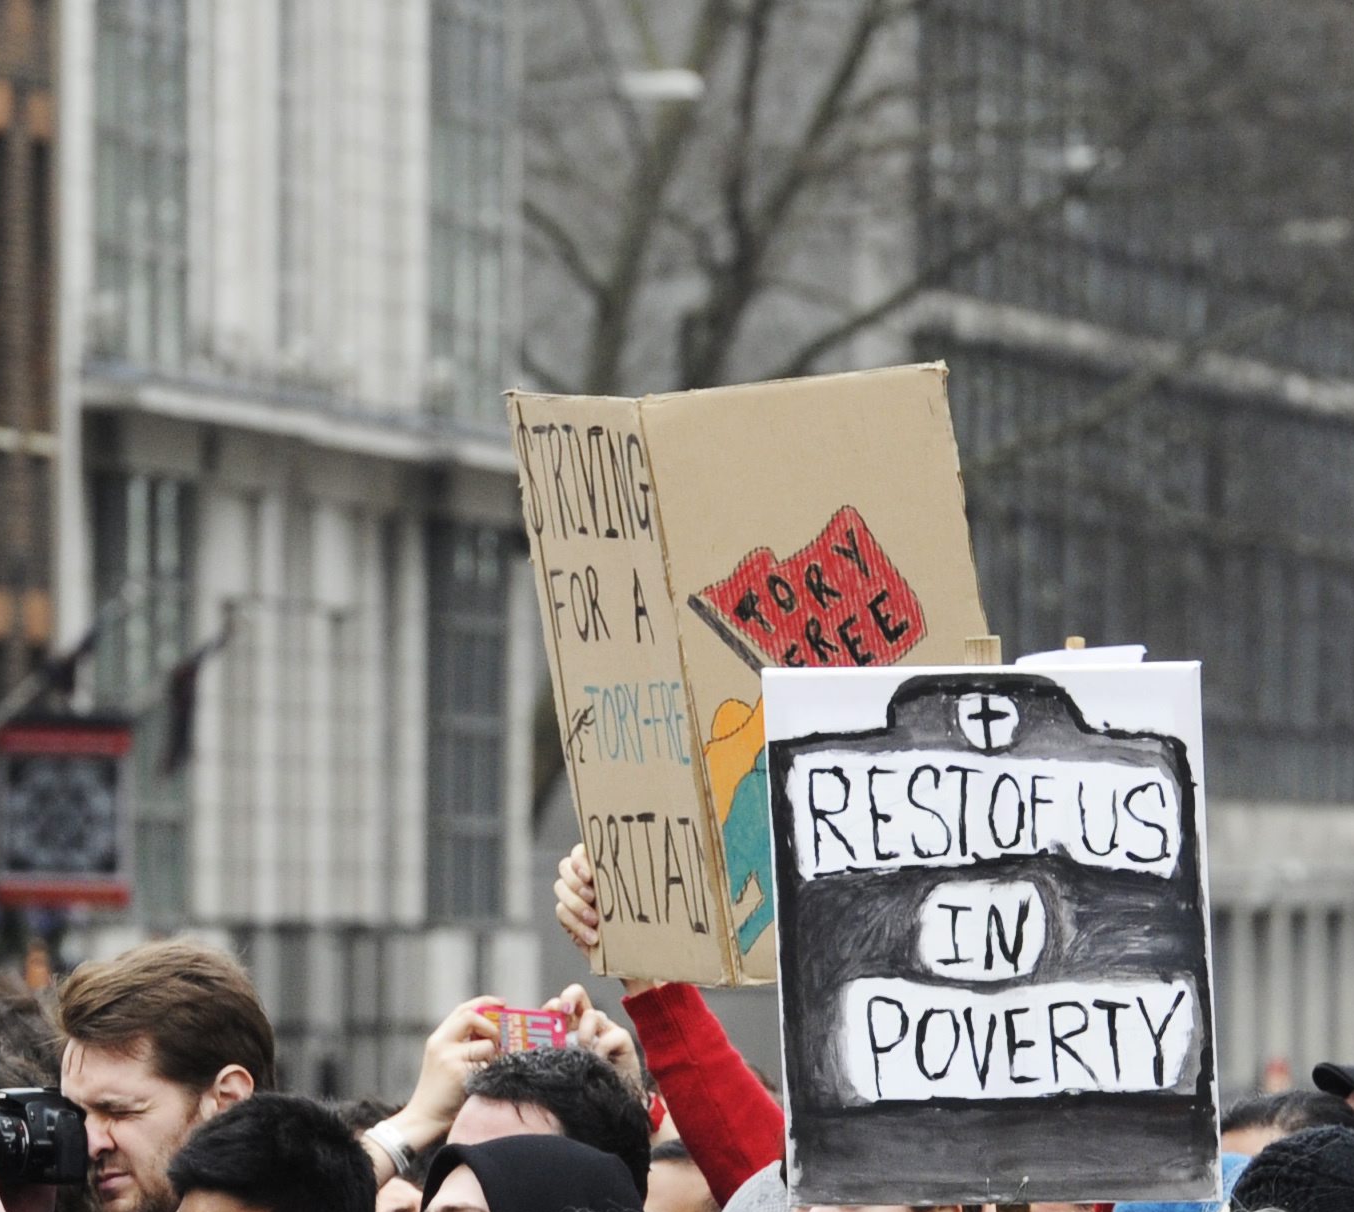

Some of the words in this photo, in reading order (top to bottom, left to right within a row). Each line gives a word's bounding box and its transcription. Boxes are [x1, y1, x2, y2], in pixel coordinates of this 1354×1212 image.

[516, 422, 655, 541] STRIVING
[548, 565, 611, 643] FOR
[634, 568, 656, 645] A
[733, 528, 873, 633] TORY
[584, 681, 690, 765] TORY-FRE
[1079, 781, 1170, 863] US
[937, 895, 1032, 974] IN
[867, 991, 1185, 1097] POVERTY
